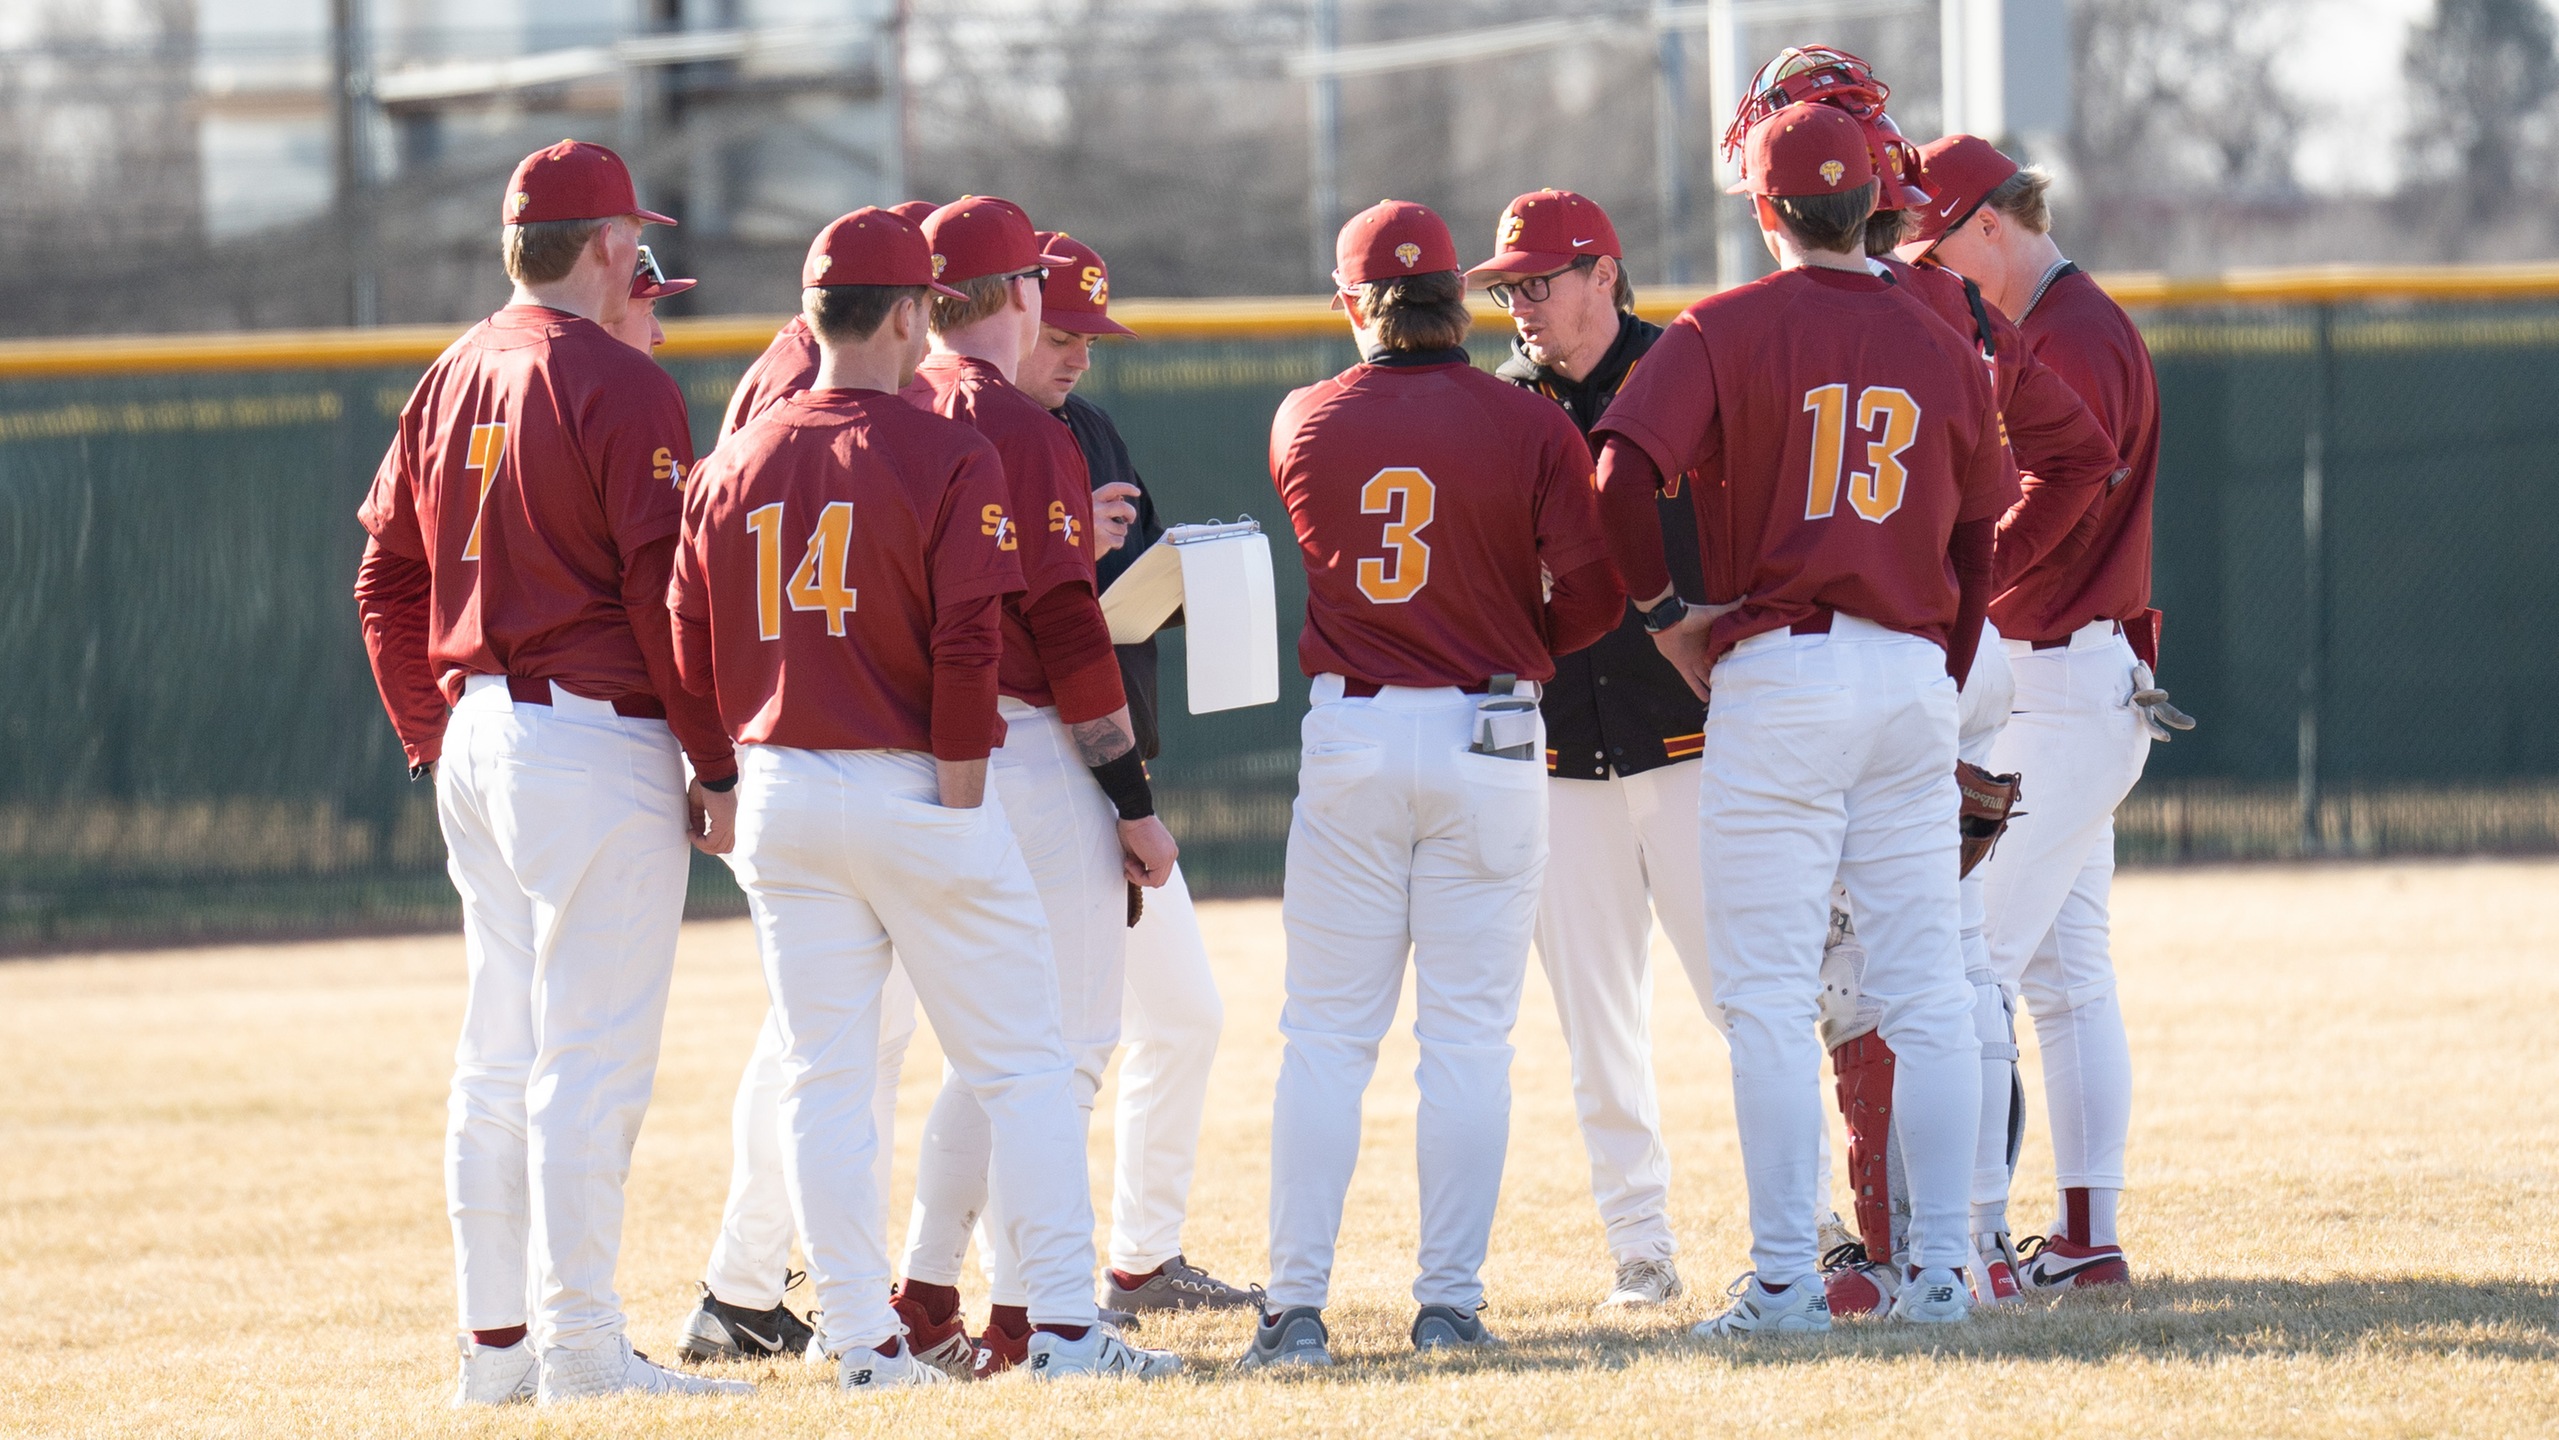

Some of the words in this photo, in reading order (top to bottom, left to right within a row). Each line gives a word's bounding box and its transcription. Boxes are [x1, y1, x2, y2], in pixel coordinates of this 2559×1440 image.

[1080, 266, 1108, 305] SC
[461, 422, 509, 561] 7
[1803, 383, 1921, 524] 13
[981, 504, 1018, 551] SC
[1047, 500, 1081, 547] SC
[1356, 467, 1436, 604] 3
[747, 501, 857, 641] 14
[1962, 786, 2005, 811] Wilson
